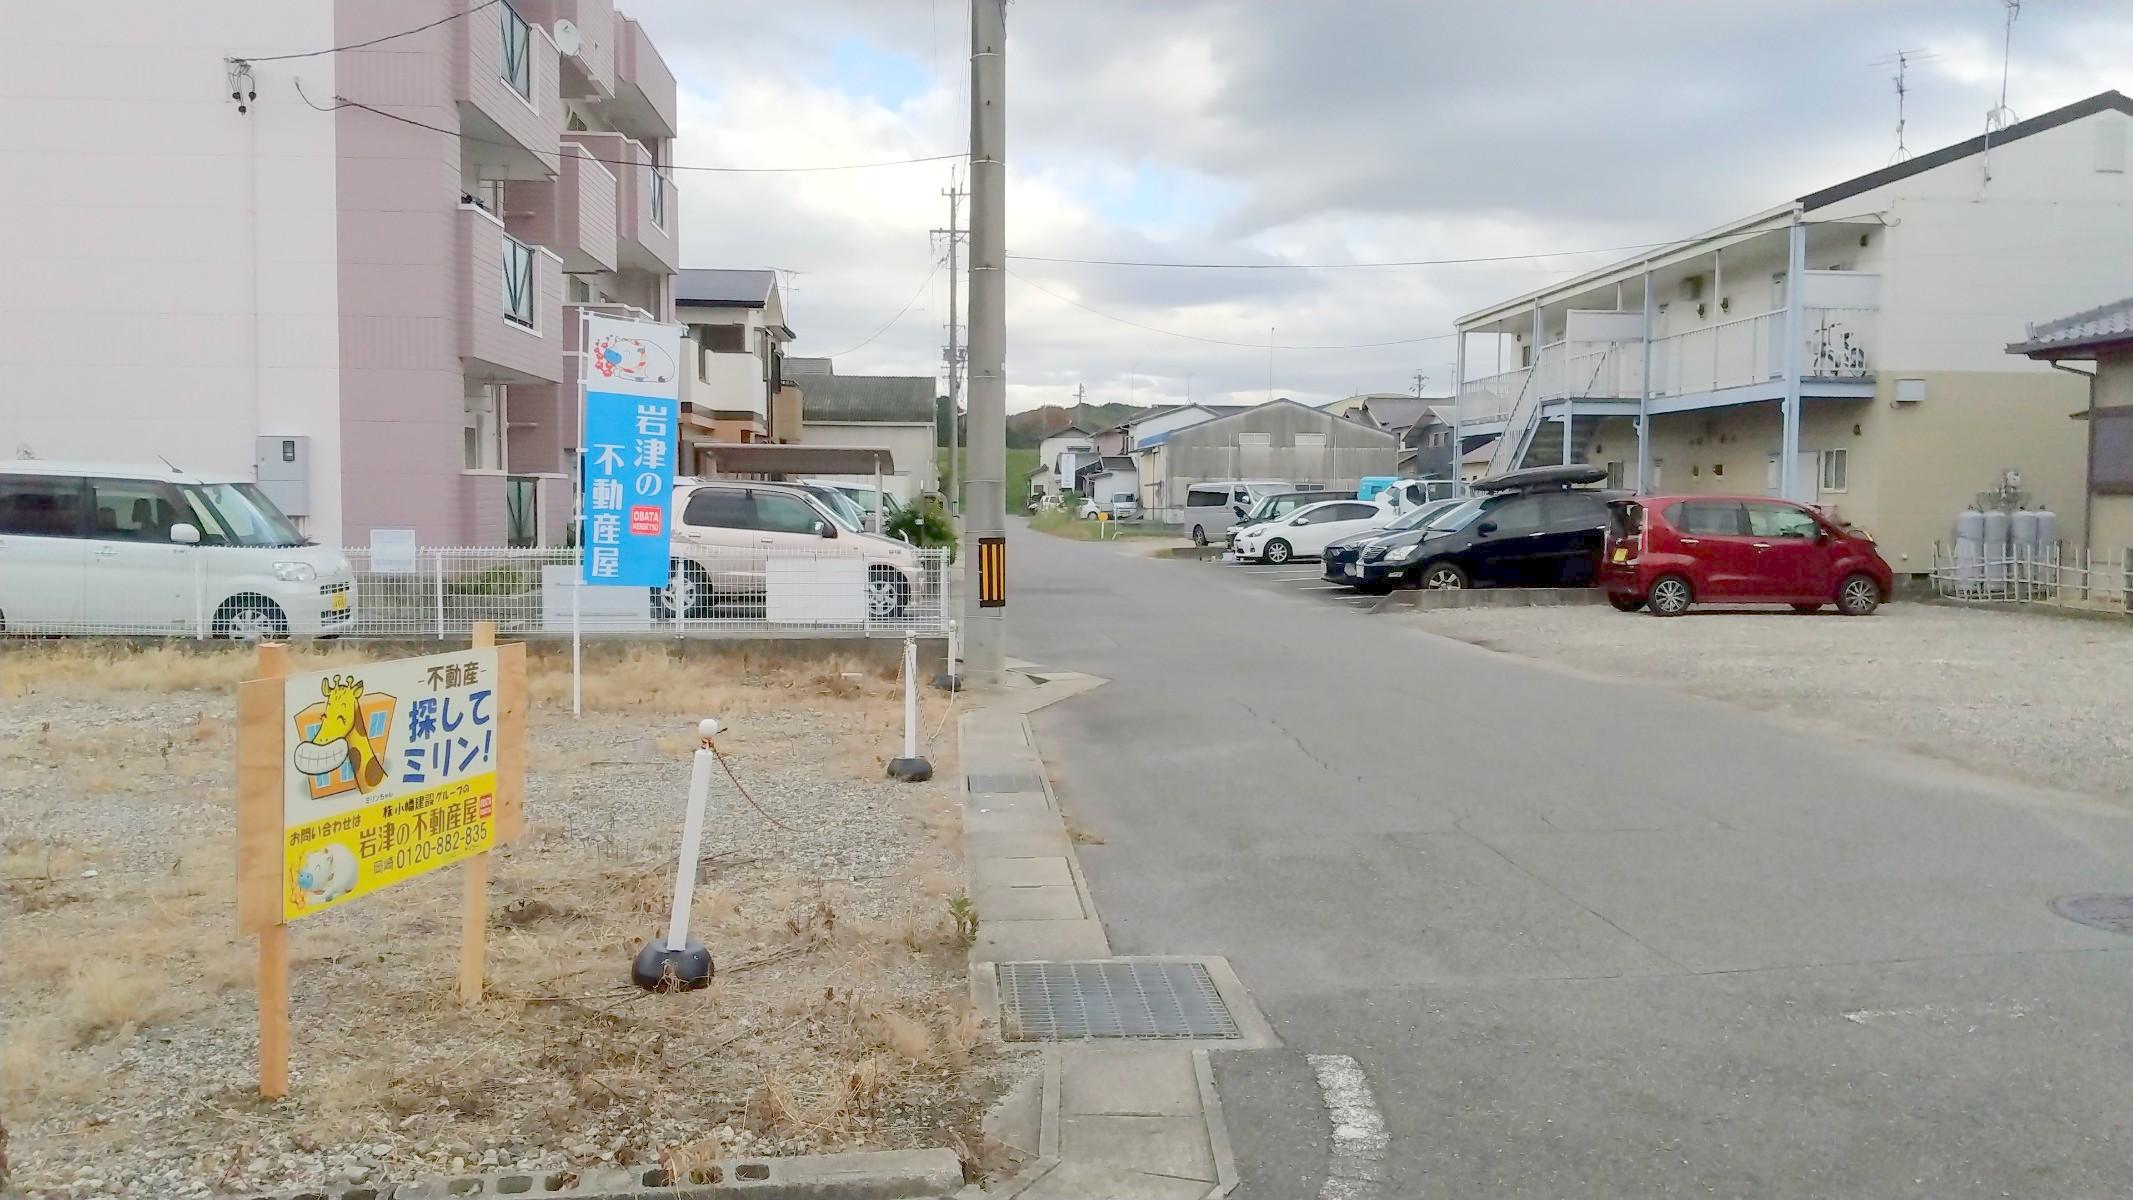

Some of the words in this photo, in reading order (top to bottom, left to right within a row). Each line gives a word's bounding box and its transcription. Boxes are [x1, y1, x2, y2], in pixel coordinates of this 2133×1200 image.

[633, 405, 667, 496] 岩津の
[592, 443, 625, 578] 不動産屋
[633, 510, 659, 522] OBATA
[408, 690, 492, 743] 探して
[289, 814, 362, 847] お問い合わせは
[359, 797, 478, 859] 岩津の不動産屋
[396, 821, 488, 869] 0120-882-835
